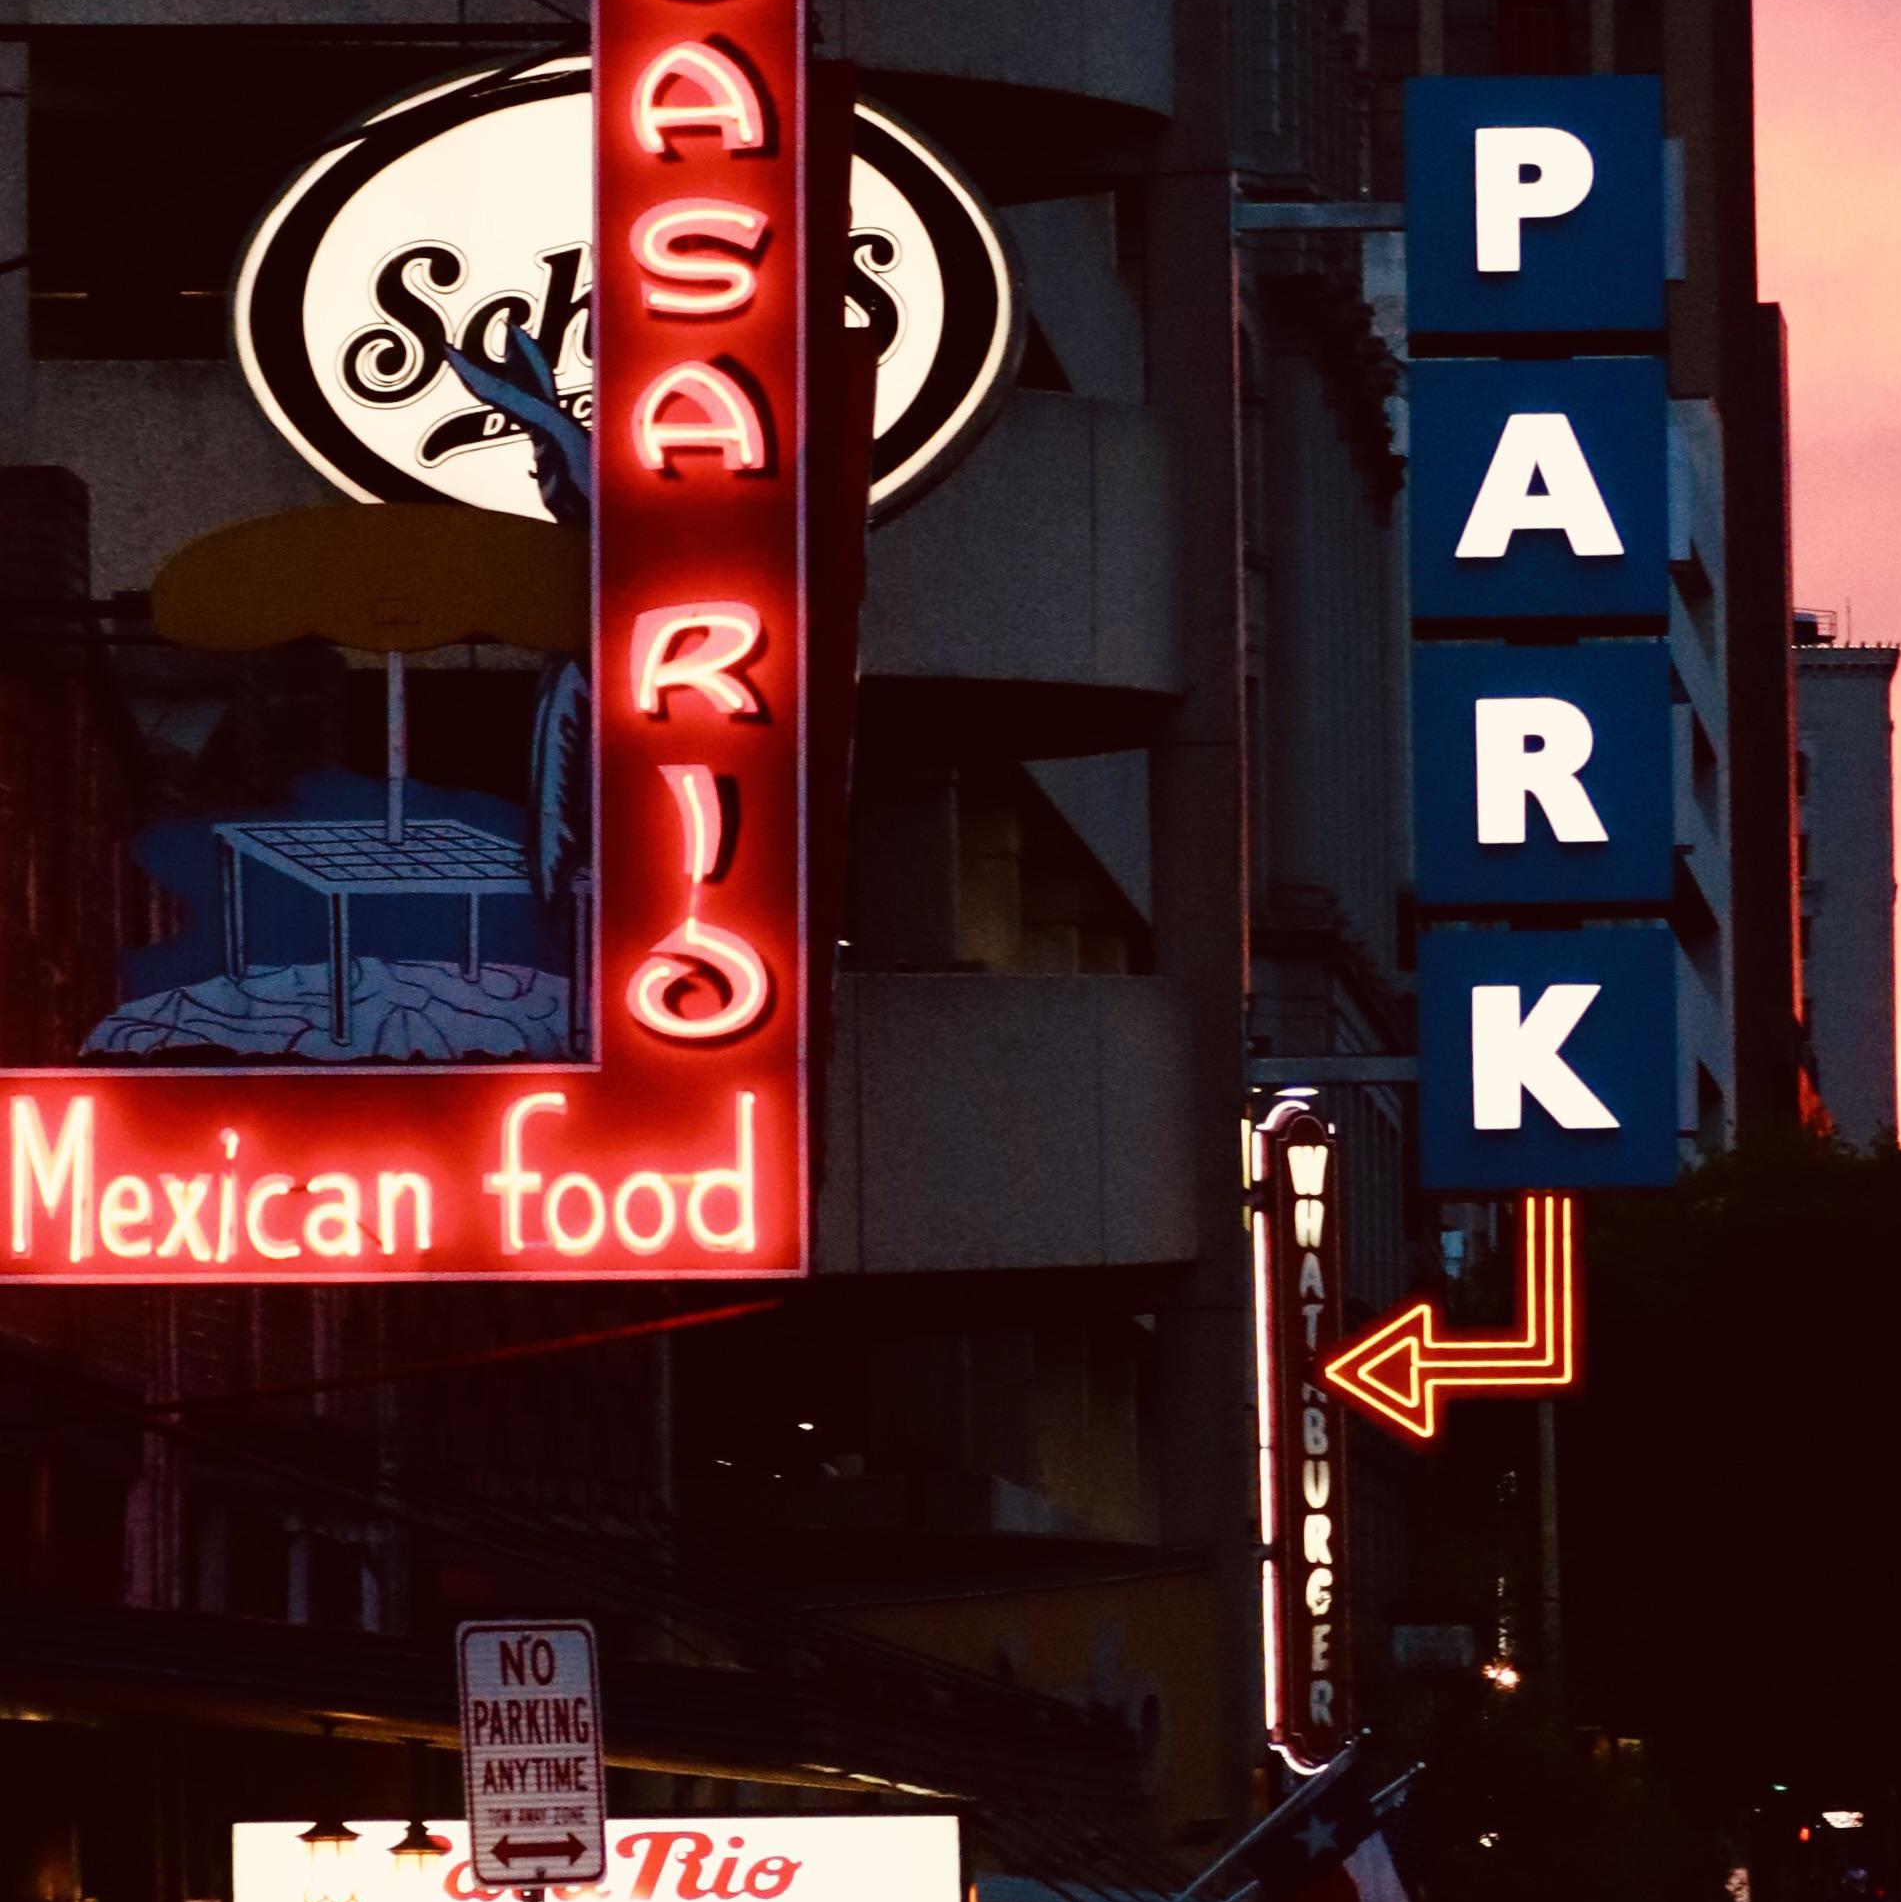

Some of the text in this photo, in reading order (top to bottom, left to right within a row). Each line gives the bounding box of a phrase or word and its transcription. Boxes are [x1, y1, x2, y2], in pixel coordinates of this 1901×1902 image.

[1453, 126, 1625, 1130] PARK
[625, 601, 769, 1039] RIO
[10, 1091, 757, 1262] Mexican food
[500, 1639, 554, 1686] NO
[473, 1698, 589, 1746] PARKING
[483, 1756, 588, 1794] ANYTIME
[614, 1830, 803, 1901] Rio
